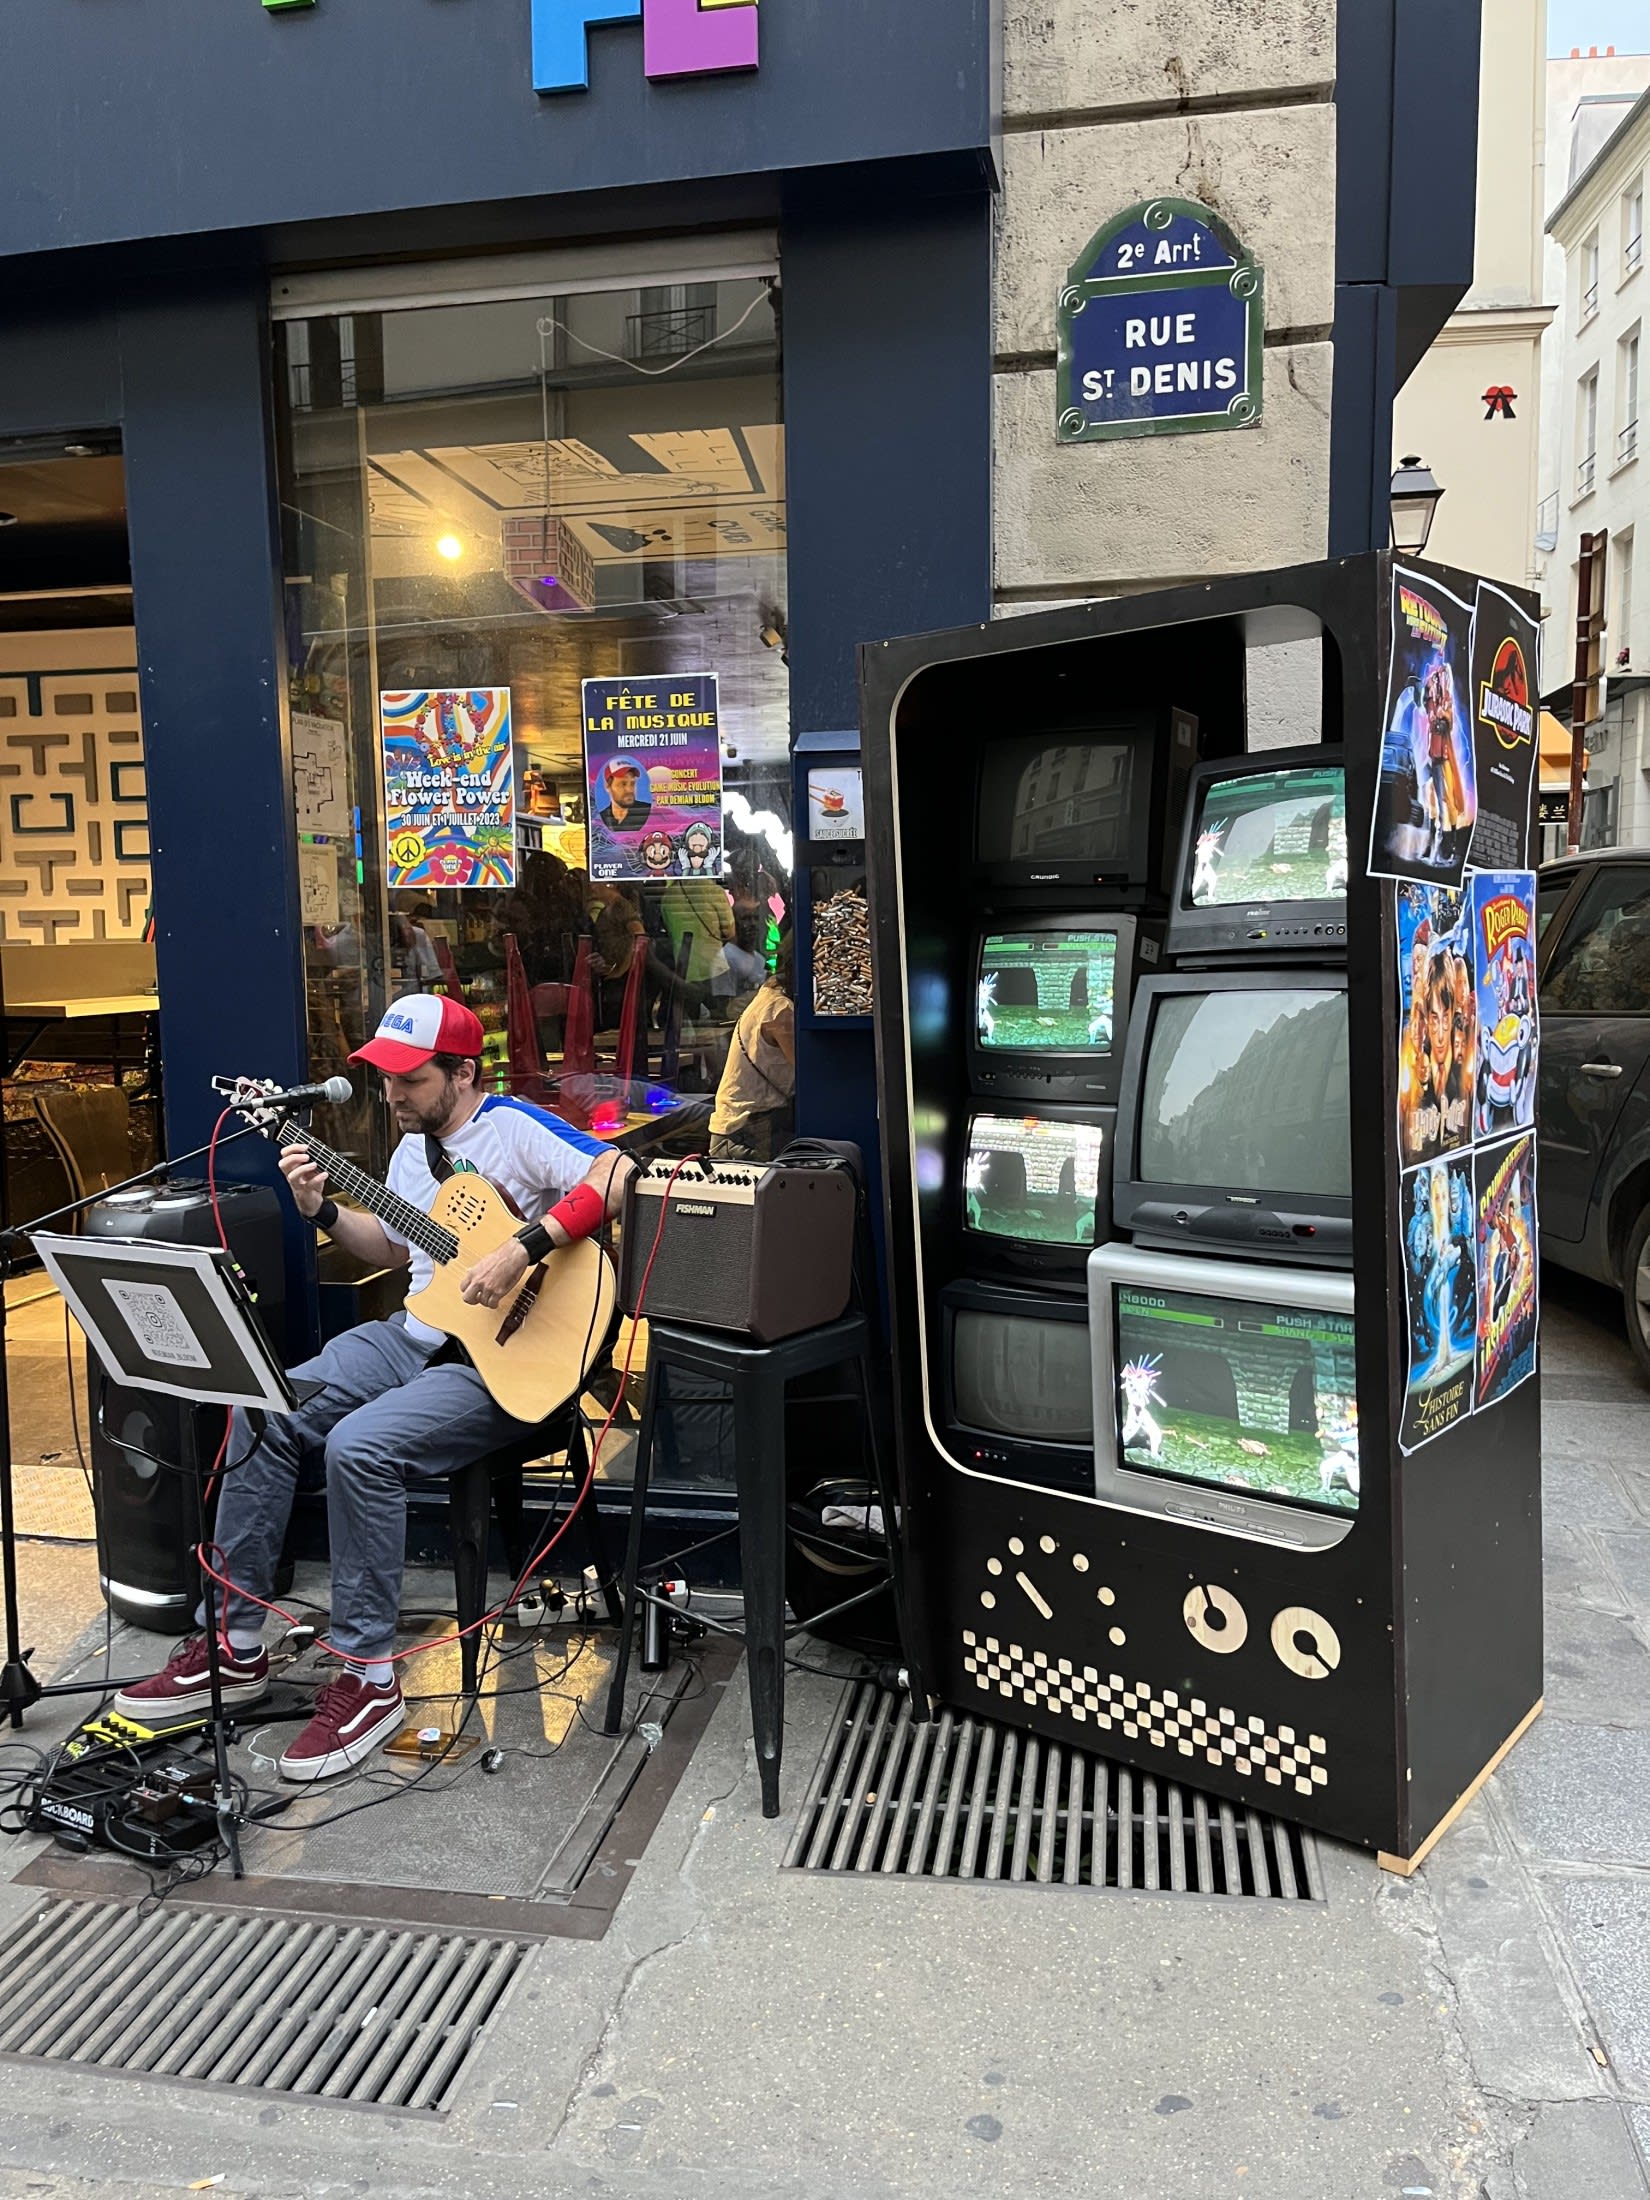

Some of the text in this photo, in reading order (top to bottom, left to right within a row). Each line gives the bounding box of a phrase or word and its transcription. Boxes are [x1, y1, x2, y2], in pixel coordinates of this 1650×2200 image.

[1125, 313, 1196, 349] RUE
[1130, 358, 1237, 397] DENIS
[606, 687, 696, 711] FÊTE DE
[1481, 687, 1531, 736] JURASSIC PARK
[587, 712, 716, 731] LA MUSIQUE
[617, 732, 688, 748] MERCREDI 21 JUIN
[405, 770, 492, 788] Week-end
[671, 768, 698, 779] CONCERT
[390, 786, 510, 806] Flower Power
[401, 813, 410, 826] 30
[411, 813, 430, 826] JUIN
[432, 813, 441, 826] ET
[448, 812, 478, 826] JUILLET
[479, 812, 500, 826] 2023
[1067, 934, 1091, 943] PUSH
[675, 1203, 715, 1216] FISHMAN
[1275, 1315, 1312, 1329] PUSH
[1423, 1401, 1459, 1436] SANS FIN
